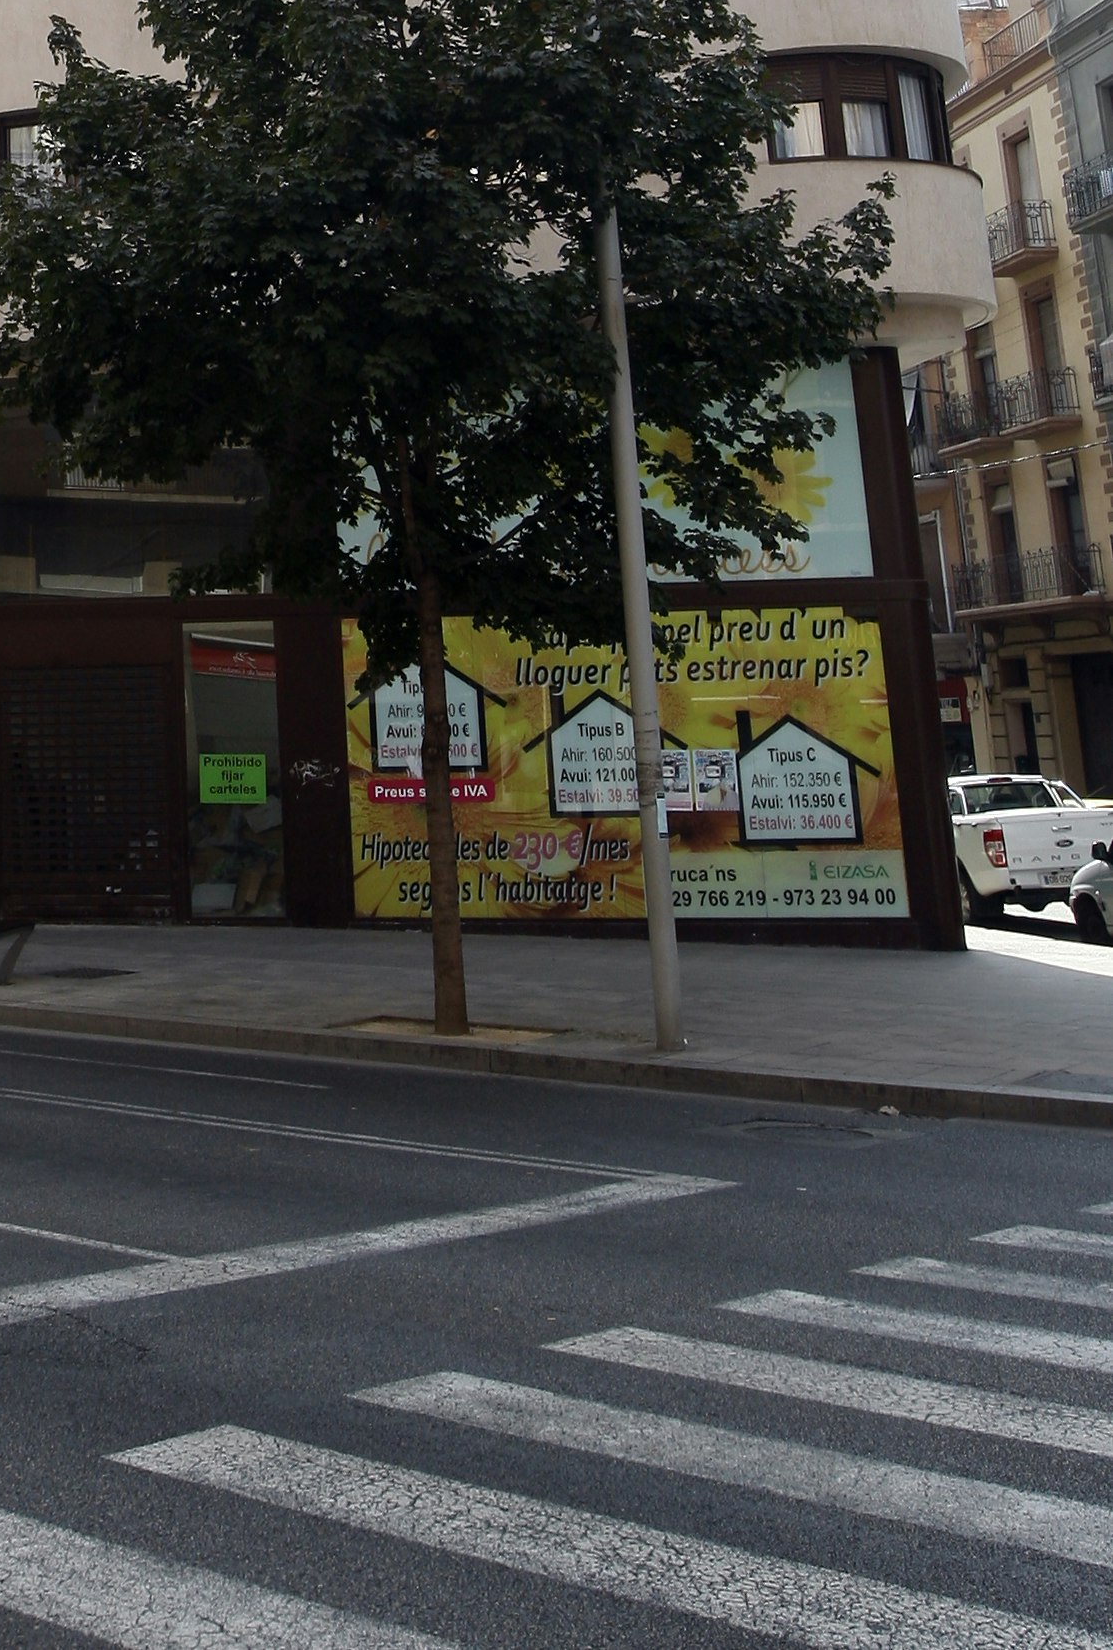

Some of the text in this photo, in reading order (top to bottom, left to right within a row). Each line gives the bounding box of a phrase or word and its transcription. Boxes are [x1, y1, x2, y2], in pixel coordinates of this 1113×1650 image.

[709, 621, 771, 651] preu
[514, 649, 870, 696] lloguer pts estrenar pis?
[401, 680, 425, 696] Tipu
[387, 704, 414, 718] Ahir:
[458, 703, 467, 717] €
[387, 724, 417, 739] Avui:
[462, 723, 470, 737] €
[578, 722, 625, 741] Tipus B
[470, 743, 479, 758] €
[561, 747, 637, 762] Ahir: 160.500
[767, 747, 816, 765] Tipus C
[203, 756, 262, 768] Prohibido
[221, 771, 245, 785] fijar
[560, 768, 635, 783] Avui: 121.00
[751, 771, 842, 788] Ahir: 152.350 €
[209, 784, 257, 795] carteles
[374, 785, 415, 798] Preus
[464, 785, 488, 797] IVA
[559, 789, 639, 804] Estalvi: 39.50
[751, 793, 847, 809] Avui: 115.950 €
[749, 814, 853, 830] Estalvi: 36.400 €
[486, 834, 510, 860] de
[513, 831, 558, 870] 230
[824, 864, 890, 878] EIZASA
[399, 879, 471, 911] segs
[609, 874, 616, 900] !
[673, 891, 692, 907] 29
[697, 891, 729, 906] 766
[735, 890, 766, 906] 219
[784, 890, 815, 905] 973
[821, 889, 842, 905] 23
[848, 889, 869, 905] 94
[875, 888, 896, 904] 00
